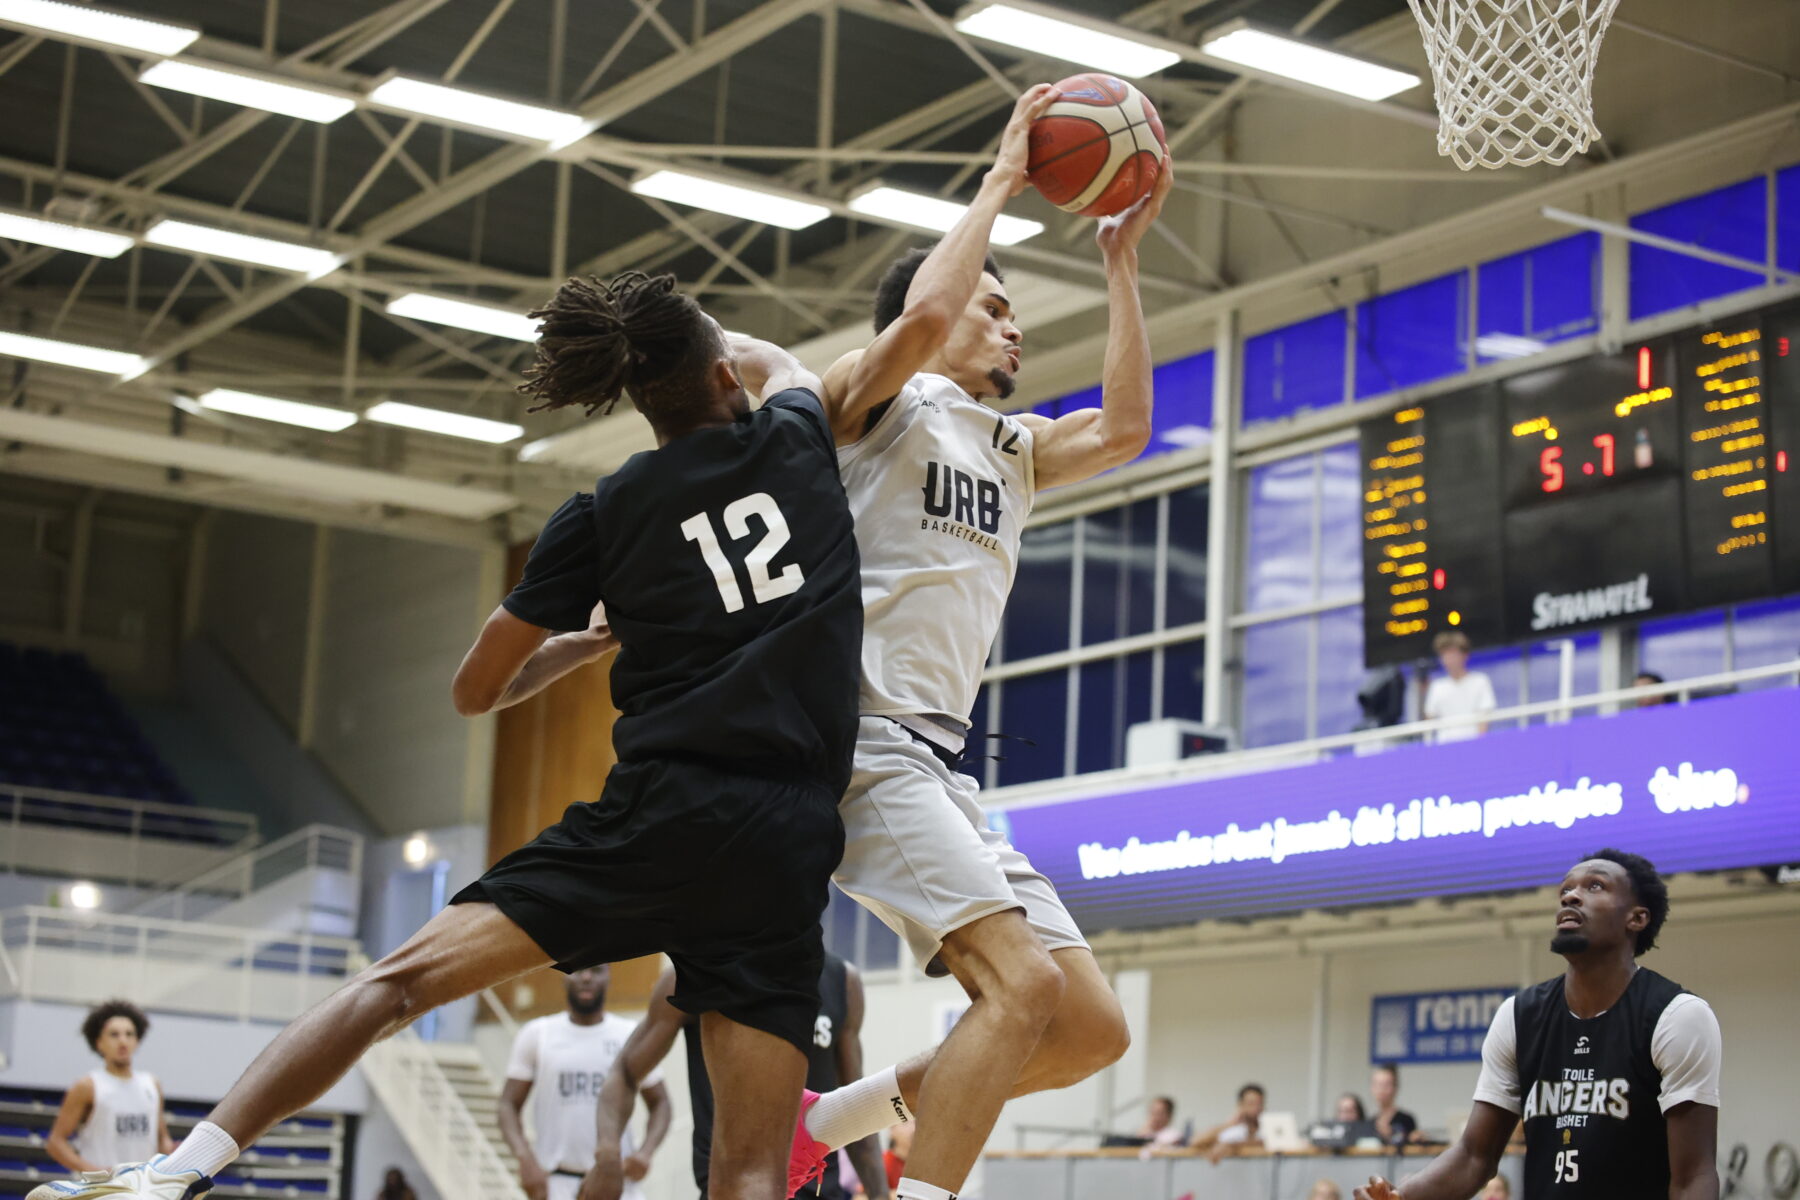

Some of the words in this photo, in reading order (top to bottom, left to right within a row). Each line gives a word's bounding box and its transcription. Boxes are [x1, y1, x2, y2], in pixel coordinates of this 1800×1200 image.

[992, 415, 1020, 456] 12
[921, 461, 1003, 535] URB
[680, 492, 806, 614] 12
[921, 518, 998, 551] BASKETBALL
[1415, 993, 1504, 1032] renn
[1562, 1068, 1595, 1081] TOILE
[1523, 1078, 1630, 1123] ANGERS
[1555, 1149, 1579, 1184] 95
